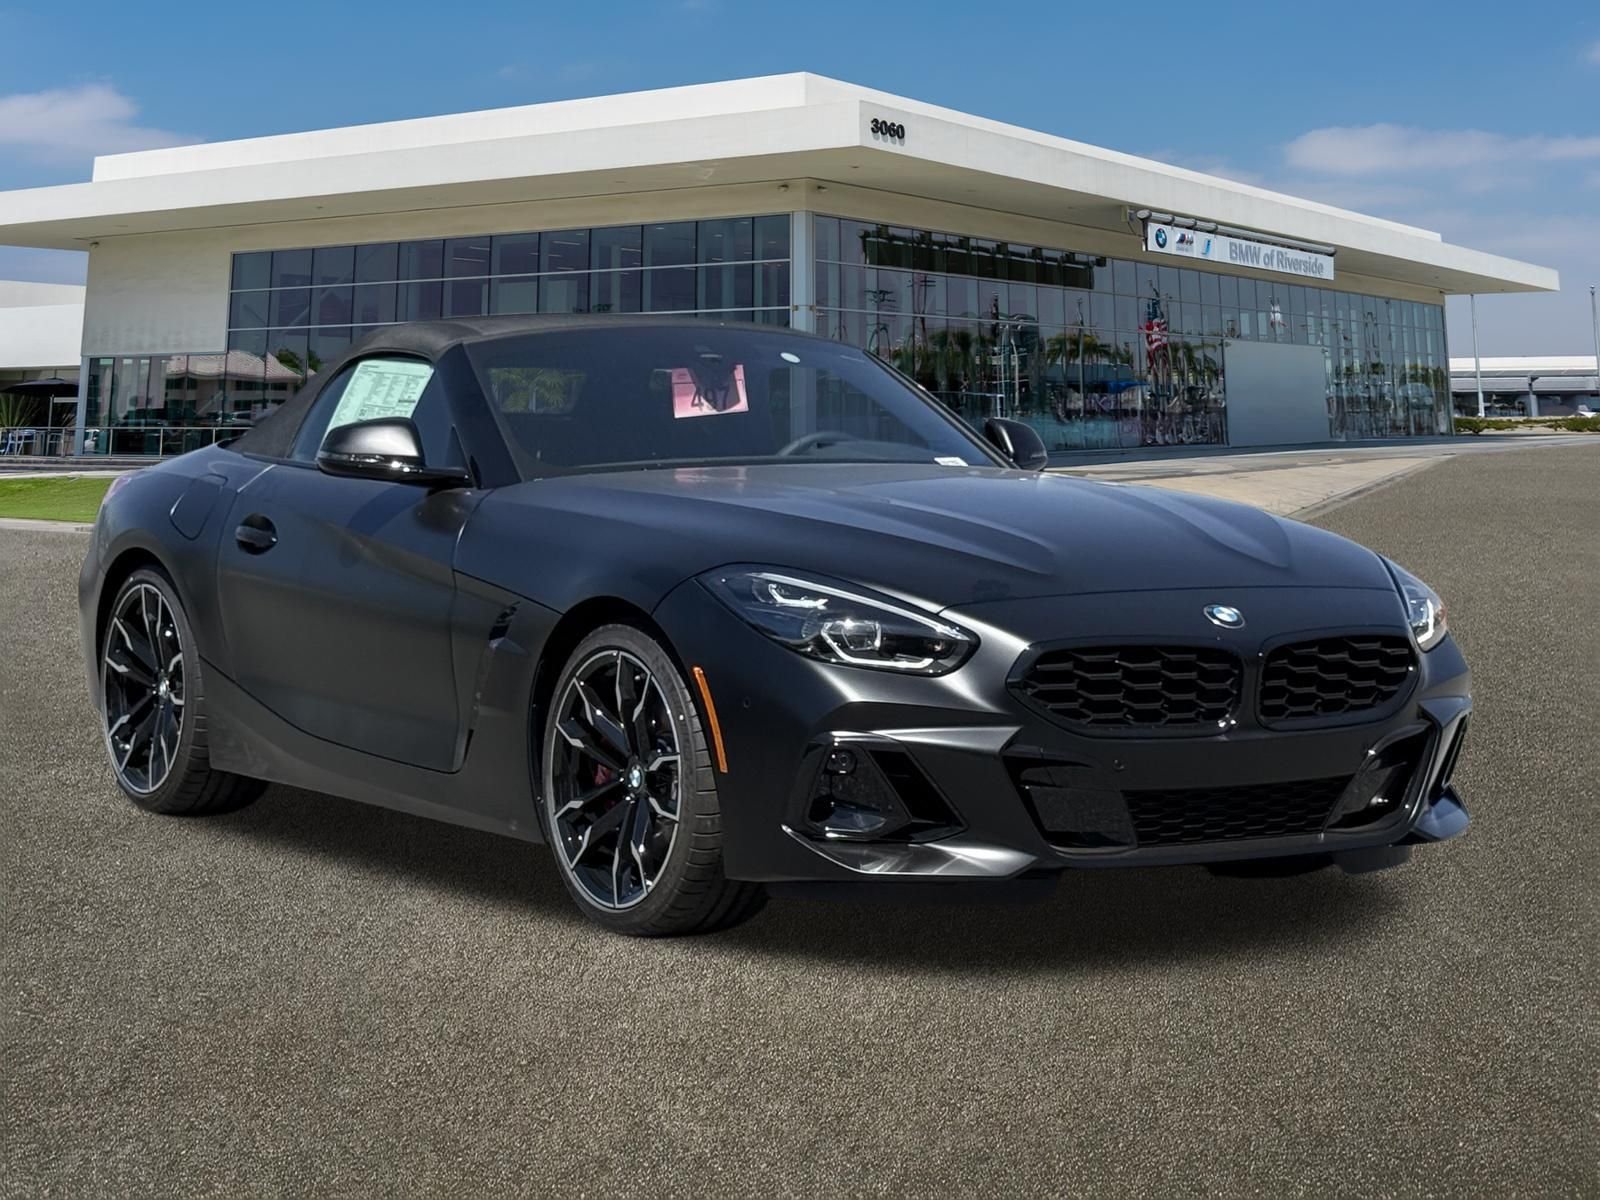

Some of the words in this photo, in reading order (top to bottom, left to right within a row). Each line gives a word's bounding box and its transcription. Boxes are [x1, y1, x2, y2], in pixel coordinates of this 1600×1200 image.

[871, 118, 905, 139] 3060
[1229, 241, 1260, 265] BMW
[1263, 249, 1275, 268] of
[1276, 251, 1324, 275] Riverside
